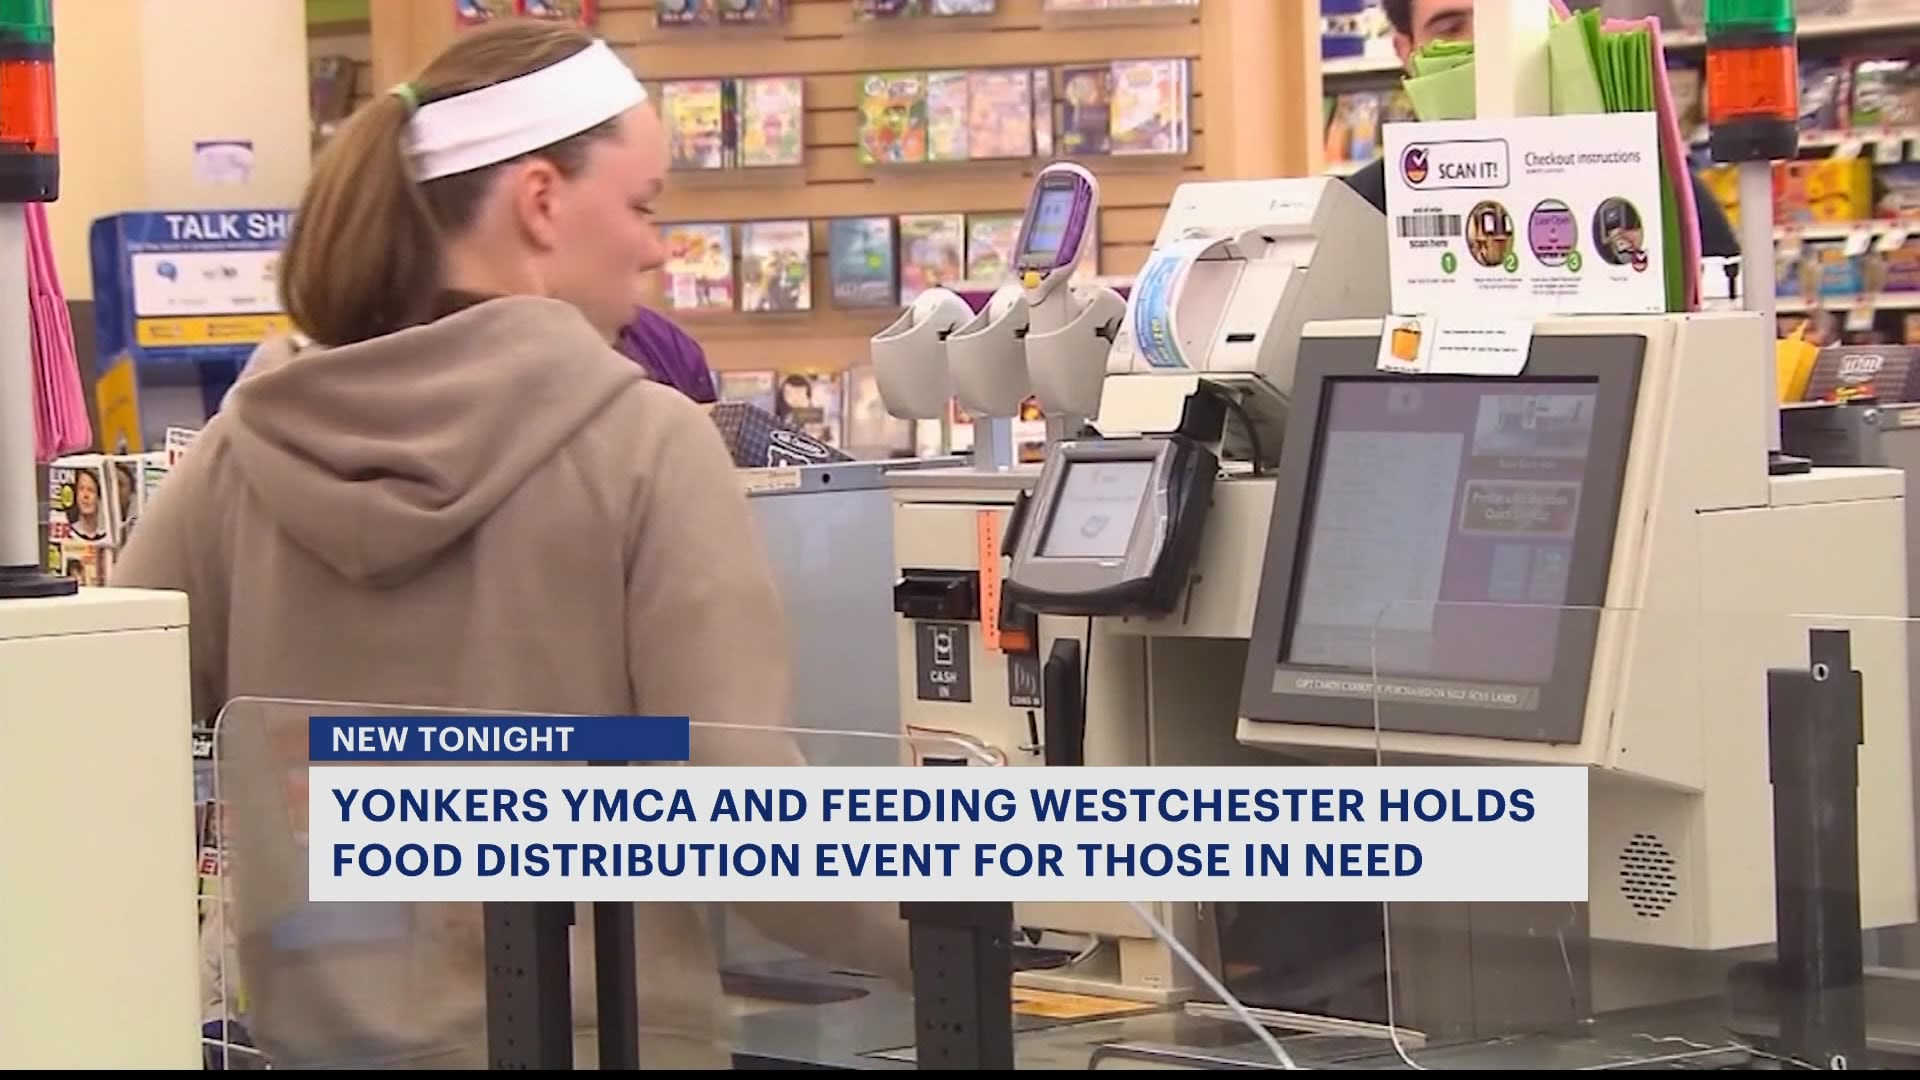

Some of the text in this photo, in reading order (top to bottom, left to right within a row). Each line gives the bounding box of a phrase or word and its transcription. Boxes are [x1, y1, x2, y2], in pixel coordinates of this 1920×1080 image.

[1524, 150, 1641, 167] Checkout instructions
[1438, 161, 1499, 180] SCAN IT!
[164, 213, 241, 240] TALK
[930, 671, 958, 684] CASH
